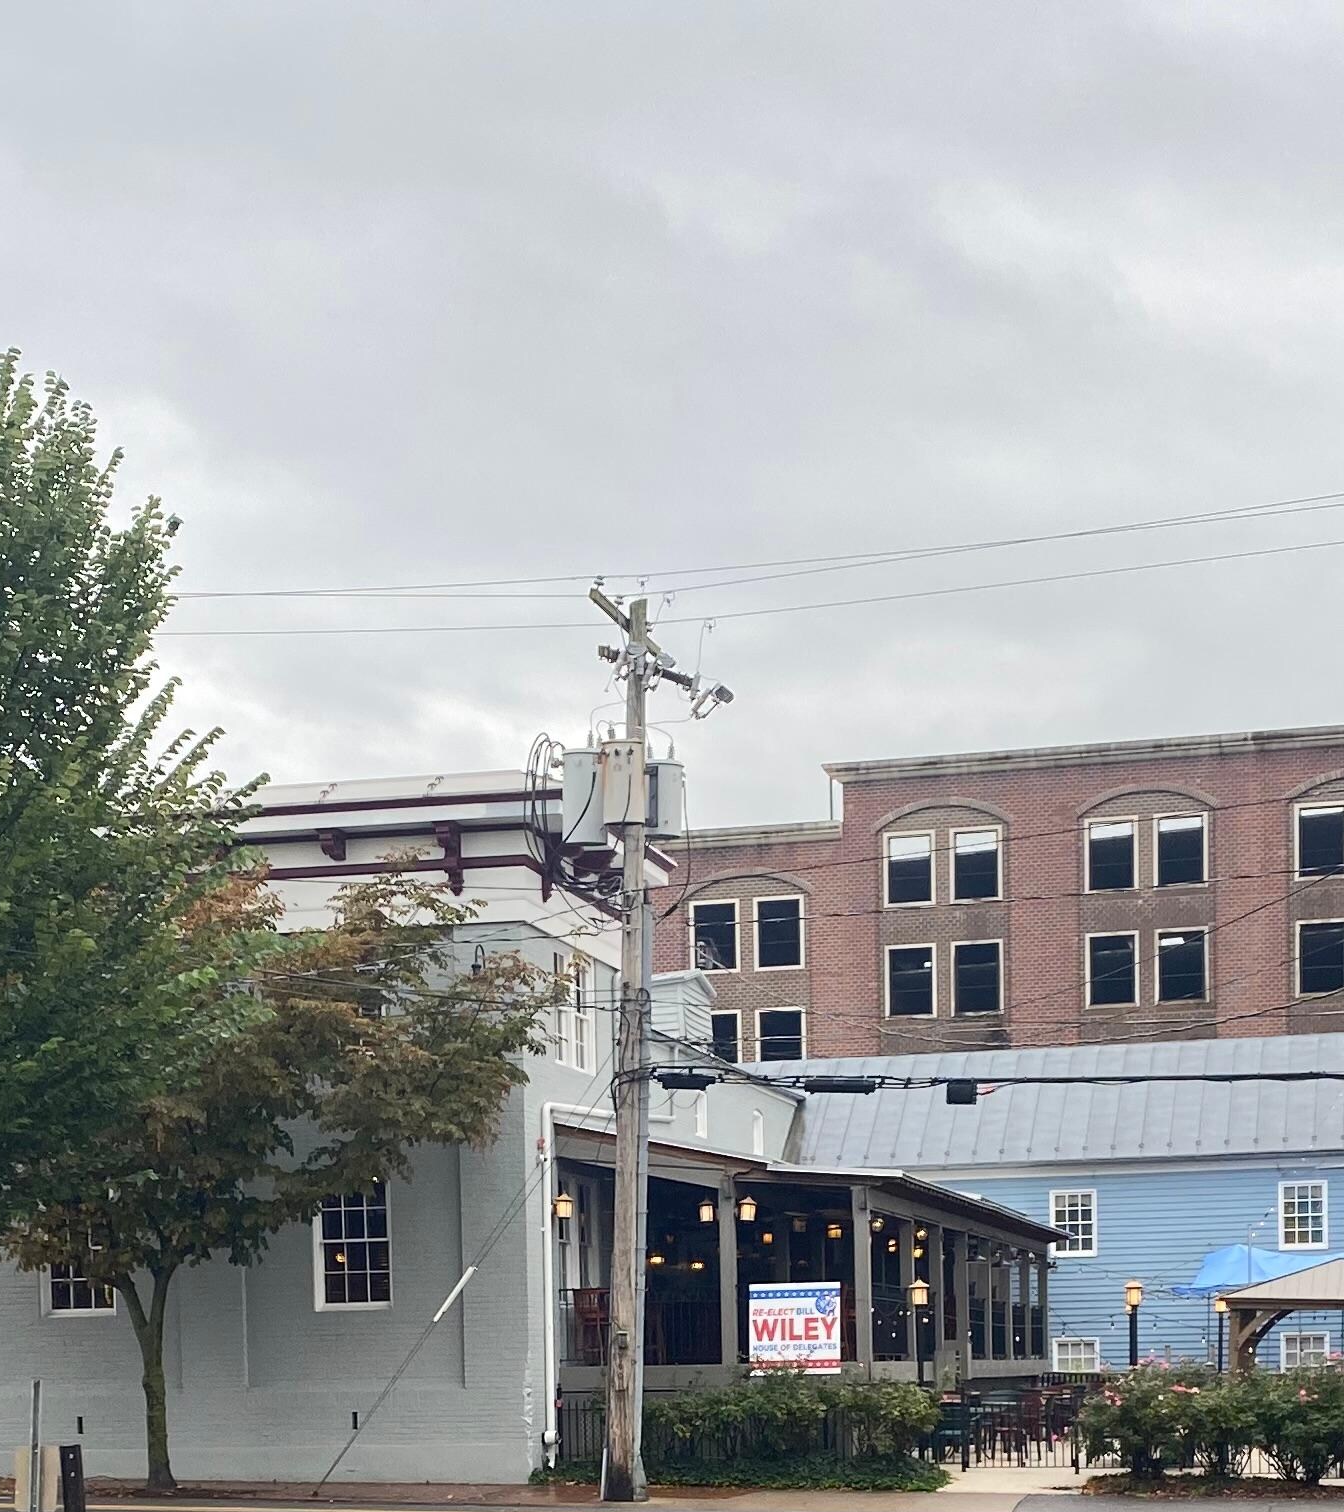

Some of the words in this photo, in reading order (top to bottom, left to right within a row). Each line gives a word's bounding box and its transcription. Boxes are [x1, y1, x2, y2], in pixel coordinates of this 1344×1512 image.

[752, 1308, 794, 1317] RE-ELECT
[796, 1307, 815, 1315] BILL
[752, 1317, 838, 1342] WILEY
[752, 1344, 778, 1352] HOUSE
[792, 1343, 837, 1351] DELEGATES
